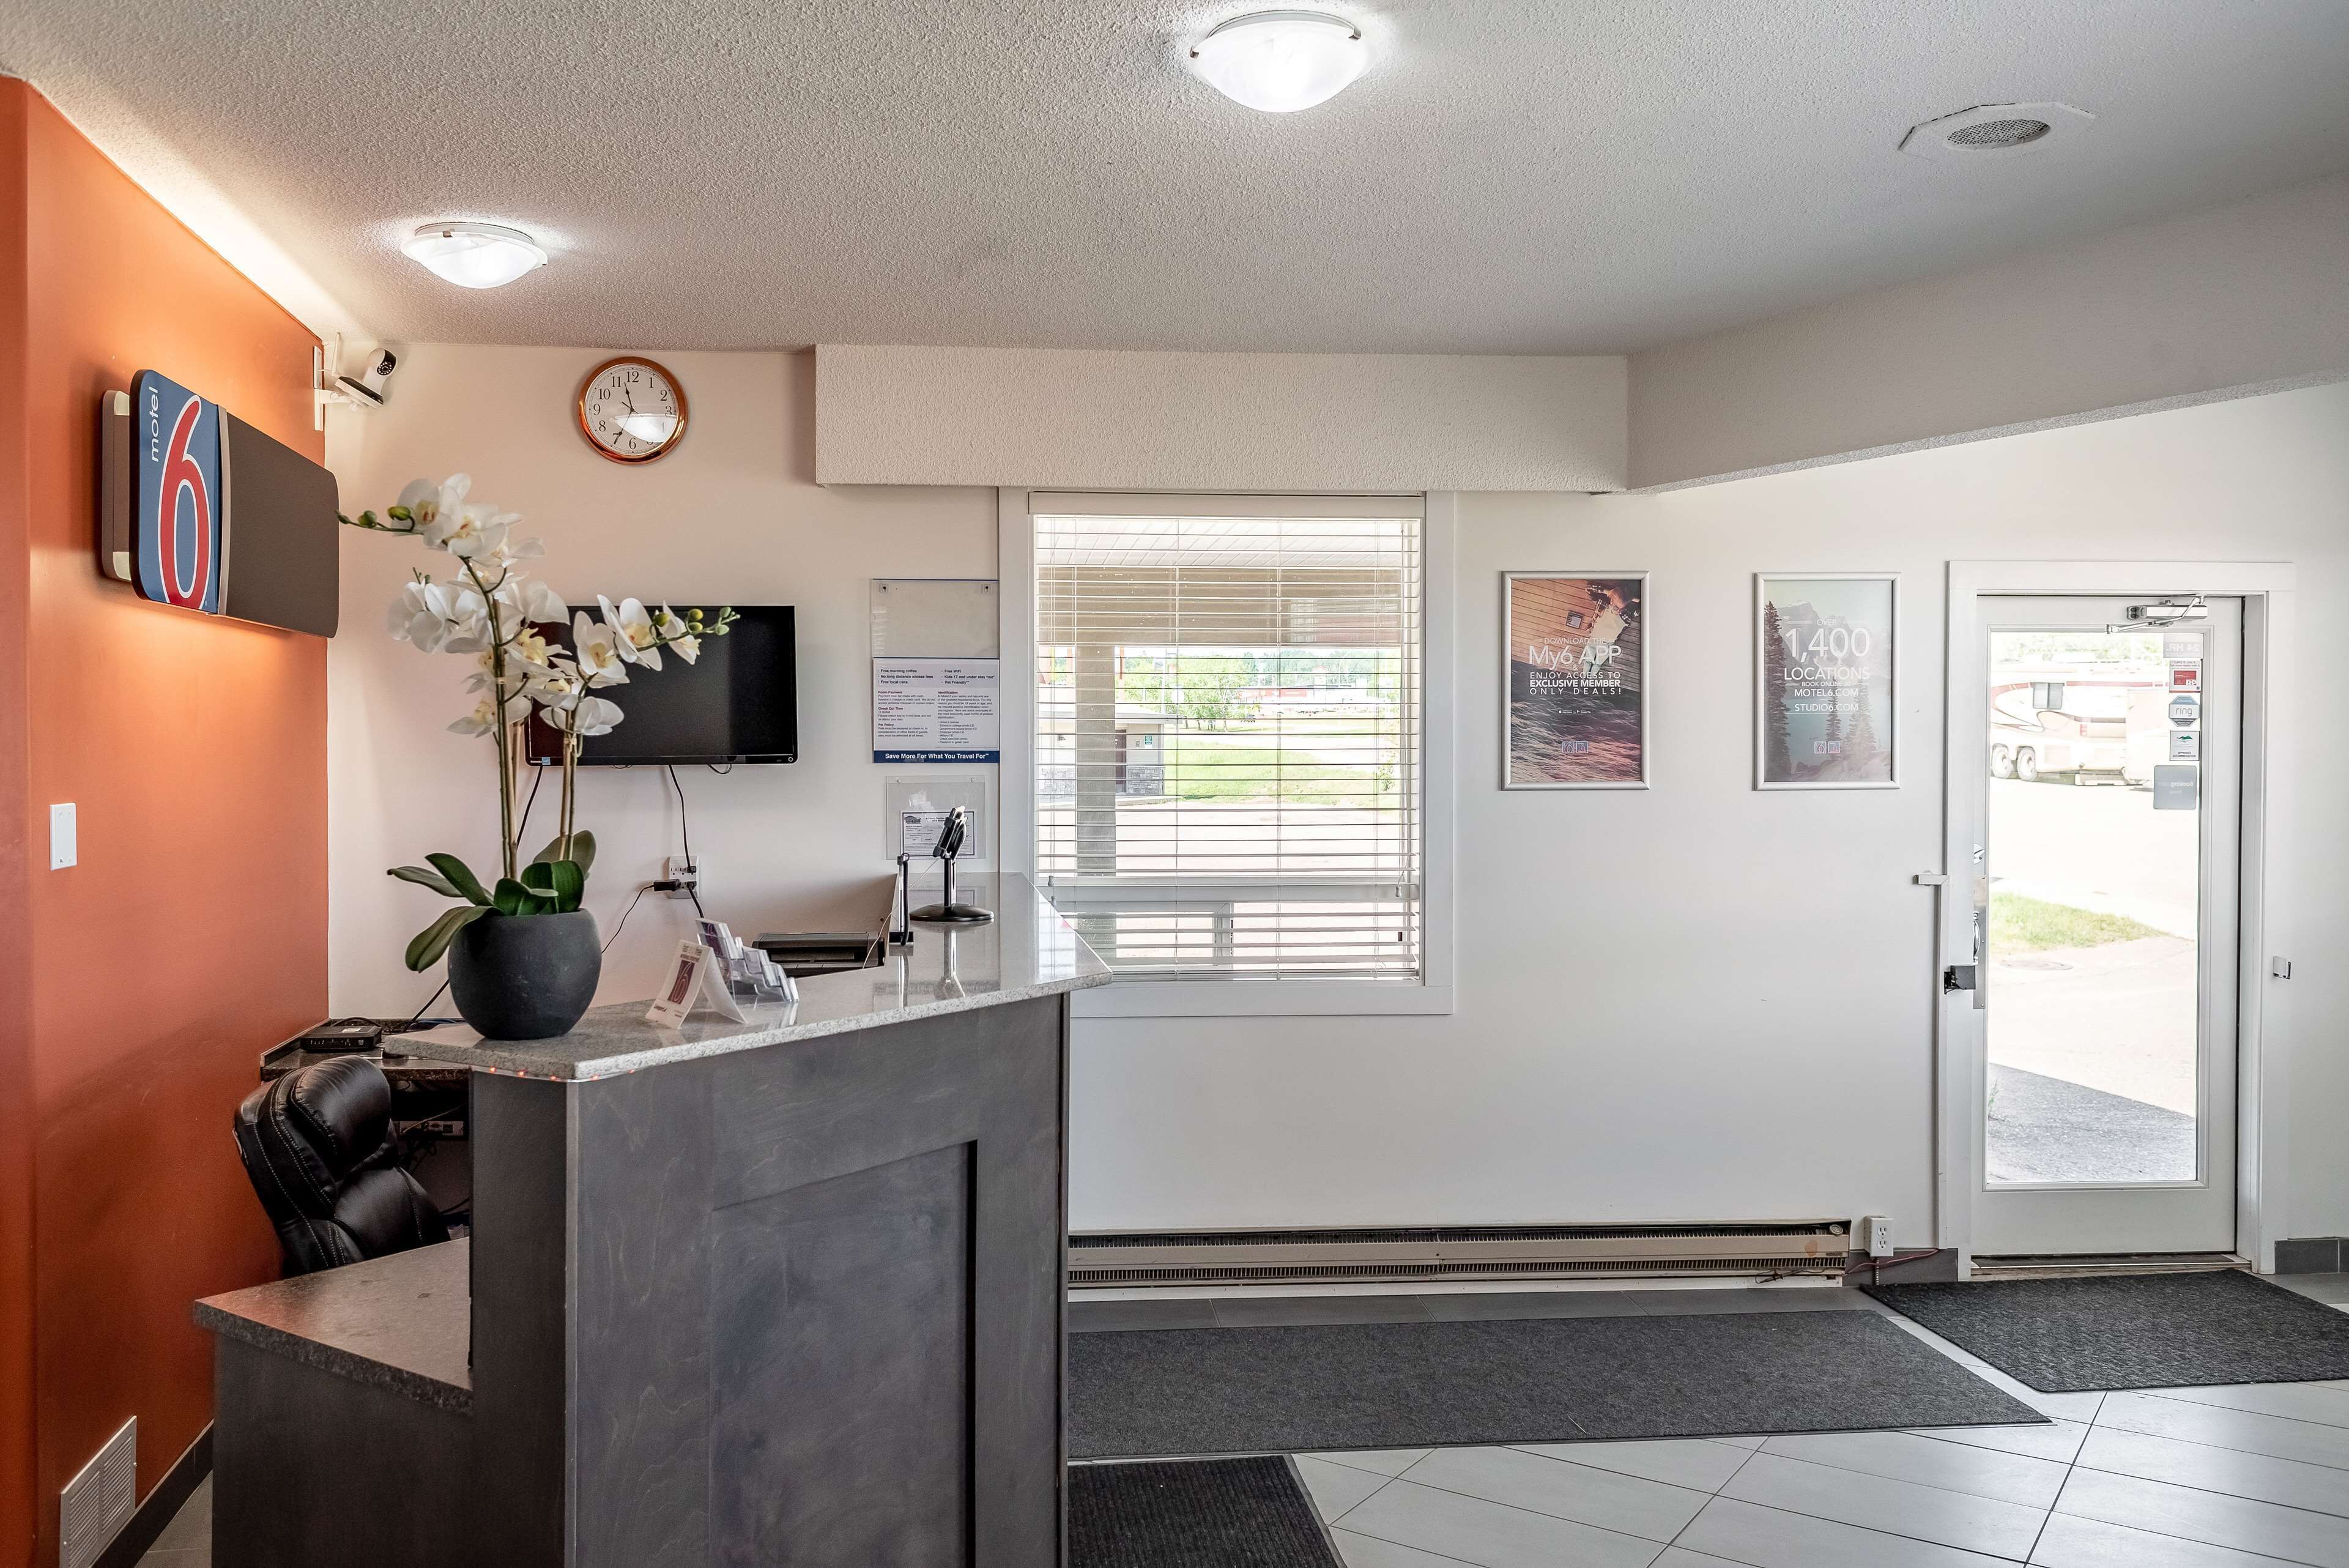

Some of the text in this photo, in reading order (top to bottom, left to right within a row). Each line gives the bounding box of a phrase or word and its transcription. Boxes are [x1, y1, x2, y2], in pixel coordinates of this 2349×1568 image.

[612, 376, 622, 387] 11
[626, 371, 639, 383] 12
[649, 377, 654, 388] 1
[599, 388, 610, 399] 10
[660, 389, 667, 401] 2
[593, 404, 601, 416] 9
[665, 406, 672, 417] 3
[149, 386, 160, 463] motel
[598, 420, 606, 432] 8
[612, 433, 622, 445] 7
[629, 437, 636, 450] 6
[157, 395, 211, 611] 6
[1816, 618, 1837, 626] OVER
[1785, 628, 1870, 663] 1,400
[1529, 645, 1622, 671] My6 APP
[1784, 667, 1870, 680] LOCATIONS
[2176, 706, 2192, 717] ring
